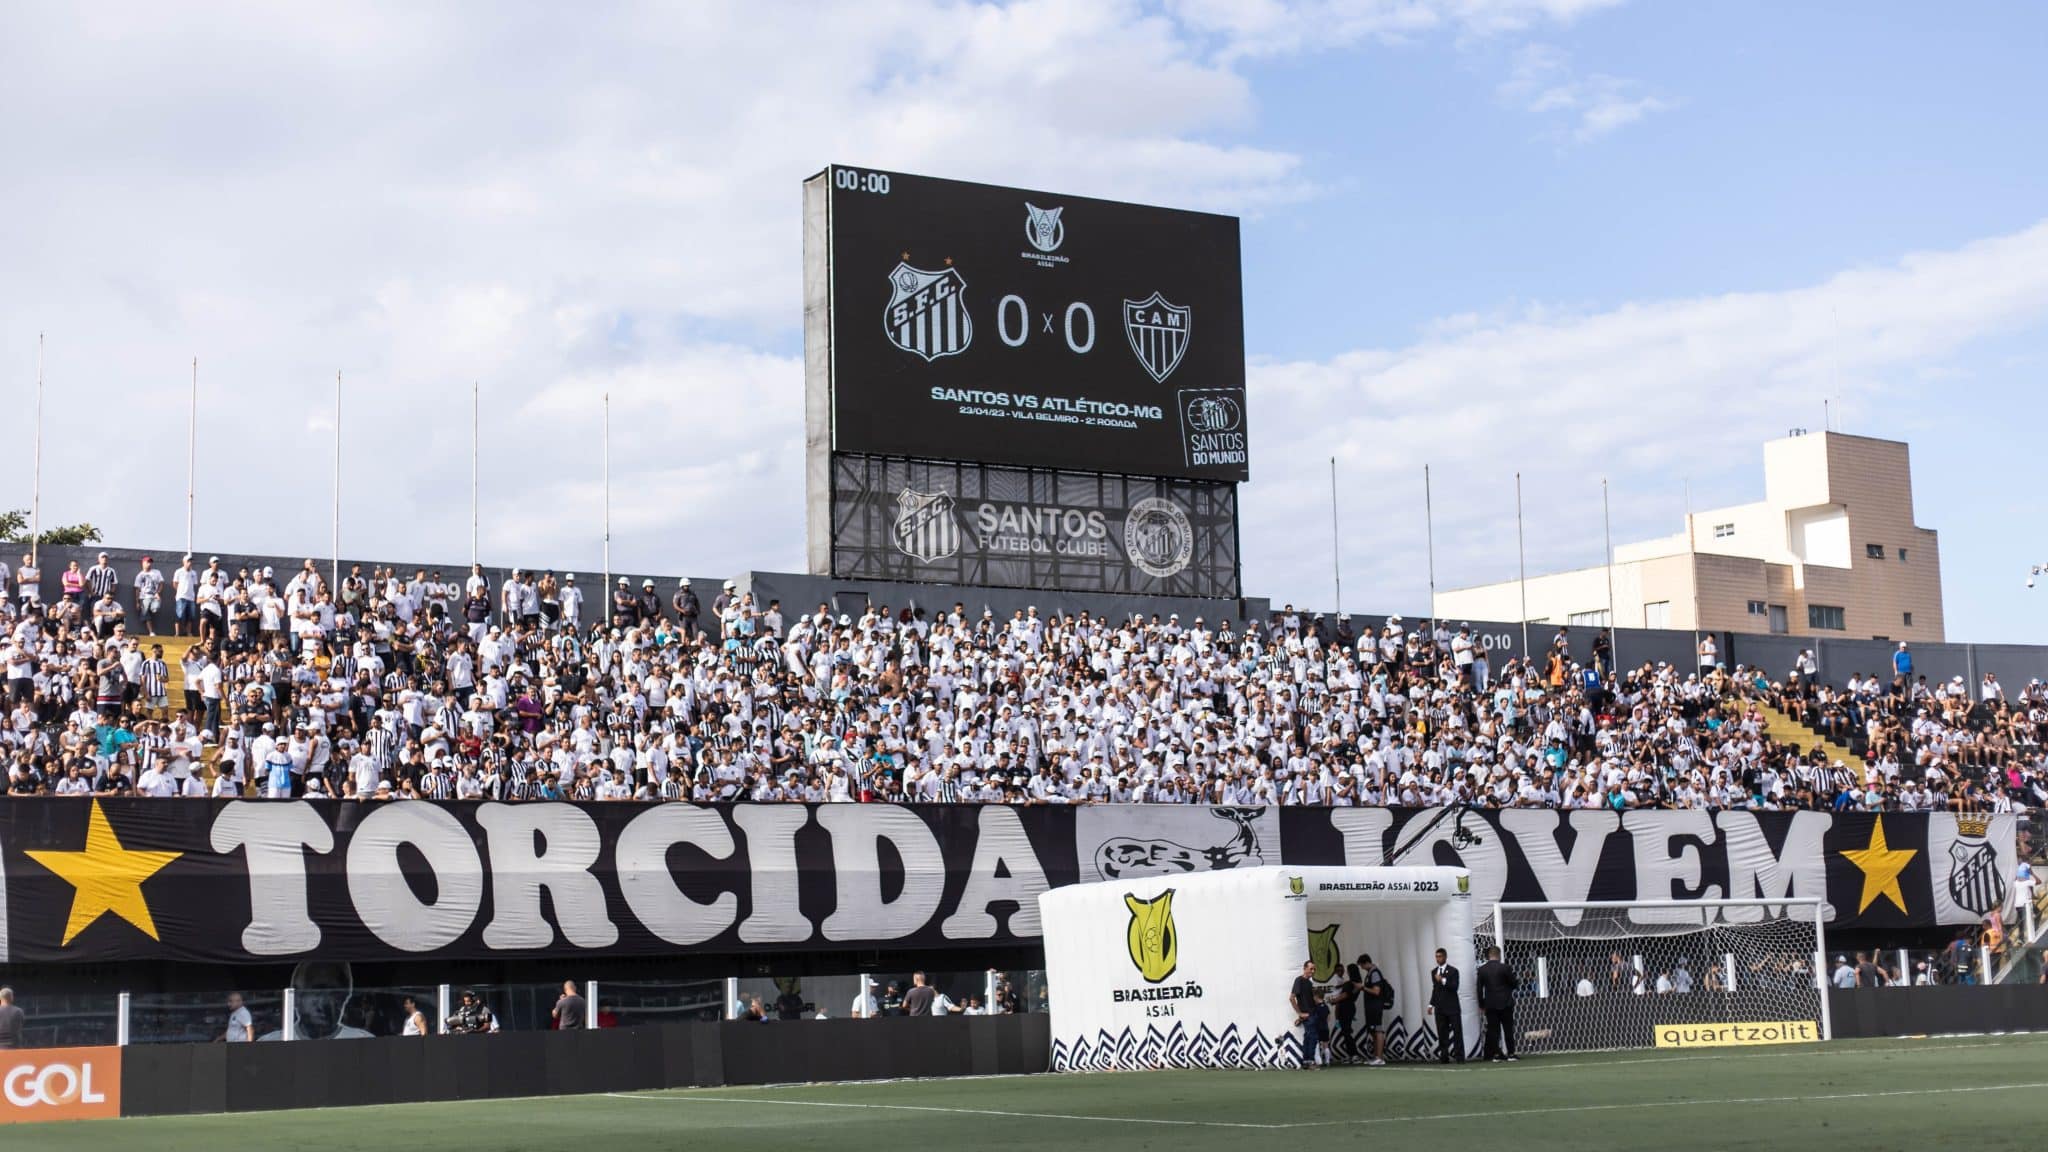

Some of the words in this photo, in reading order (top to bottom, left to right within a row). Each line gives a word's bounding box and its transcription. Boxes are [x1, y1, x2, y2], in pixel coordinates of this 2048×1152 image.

[836, 169, 890, 194] 00:00
[893, 276, 956, 327] S.F.C.
[997, 294, 1029, 347] 0
[1064, 301, 1095, 354] 0
[931, 386, 1010, 406] SANTOS
[1013, 393, 1039, 409] VS
[1042, 396, 1163, 420] ATLÉTICO-MG
[959, 405, 1005, 417] 23/04/23
[1011, 410, 1034, 420] VILA
[1035, 413, 1079, 424] BELMIRO
[1097, 418, 1138, 429] RODADA
[1191, 432, 1244, 451] SANTOS
[1193, 451, 1208, 466] DO
[1209, 450, 1246, 465] MUNDO
[978, 503, 1107, 539] SANTOS
[979, 534, 1051, 553] FUTEBOL
[1056, 539, 1108, 556] CLUBE
[210, 800, 1052, 956] TORCIDA
[1319, 881, 1385, 891] BRASILEIRÃO
[1413, 881, 1439, 892] 2023
[1113, 980, 1203, 1002] BRASILEIRÃO
[1663, 1023, 1811, 1046] quartzolit
[3, 1062, 105, 1107] GOL
